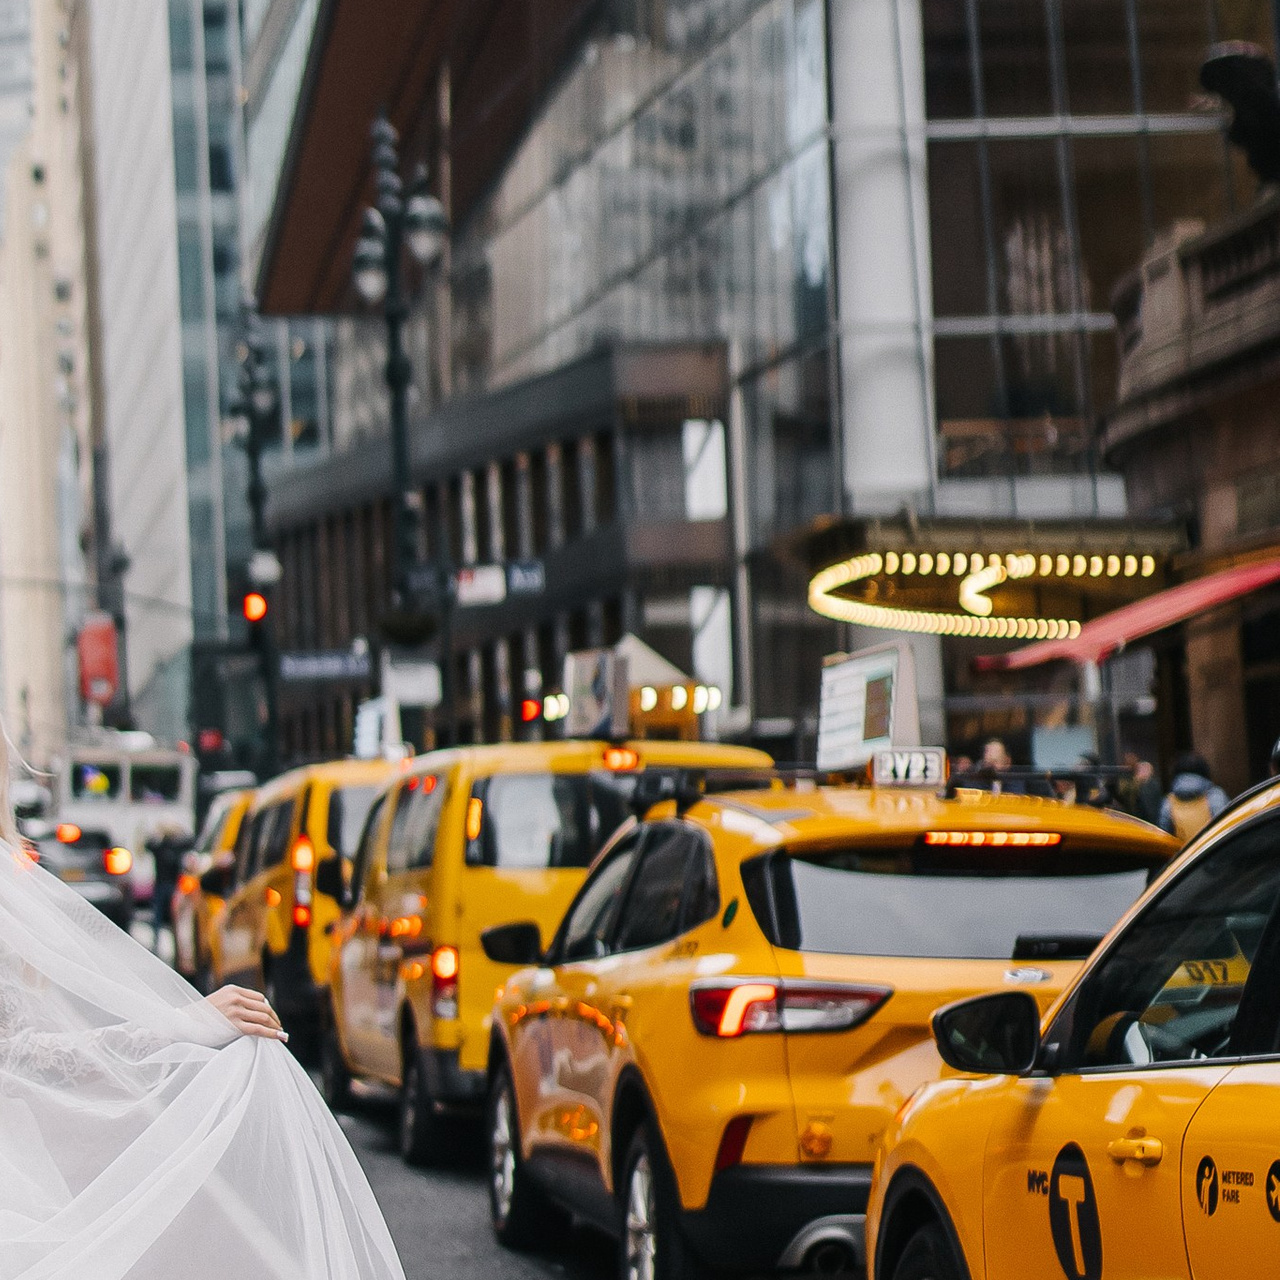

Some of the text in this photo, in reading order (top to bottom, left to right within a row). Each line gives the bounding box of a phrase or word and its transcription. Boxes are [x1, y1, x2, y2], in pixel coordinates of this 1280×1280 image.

[1027, 1169, 1048, 1196] NYC
[1222, 1170, 1254, 1187] METERED
[1222, 1188, 1240, 1204] FARE
